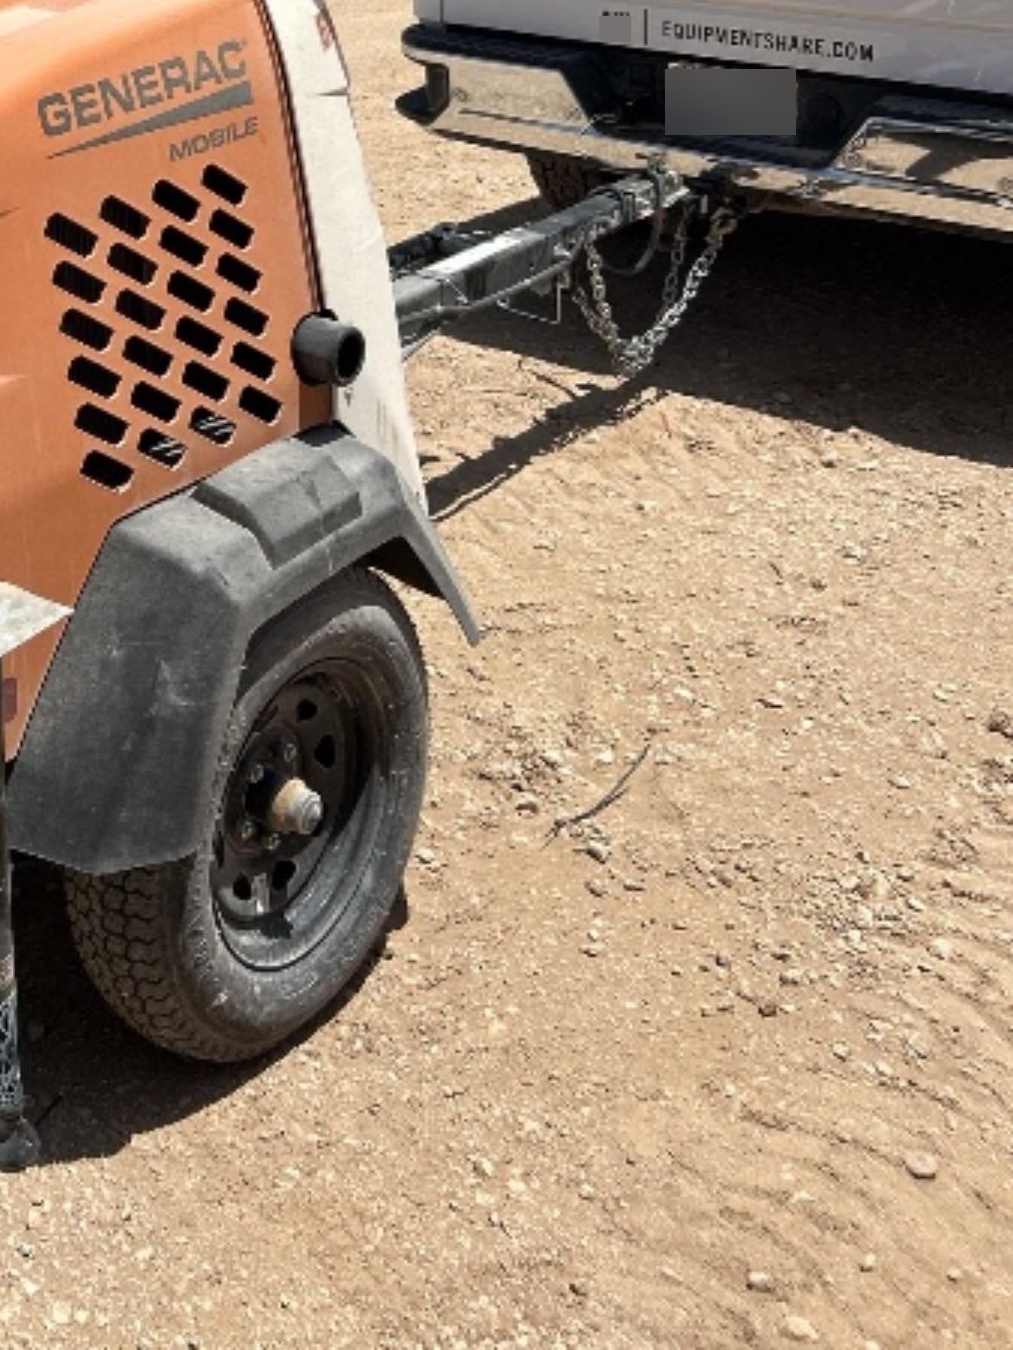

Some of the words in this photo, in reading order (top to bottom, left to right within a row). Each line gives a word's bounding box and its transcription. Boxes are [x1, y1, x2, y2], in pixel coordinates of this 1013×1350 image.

[661, 19, 874, 62] EQUIPMENTSHARE.COM
[38, 41, 246, 137] GENERAC
[169, 116, 259, 162] MOBILE
